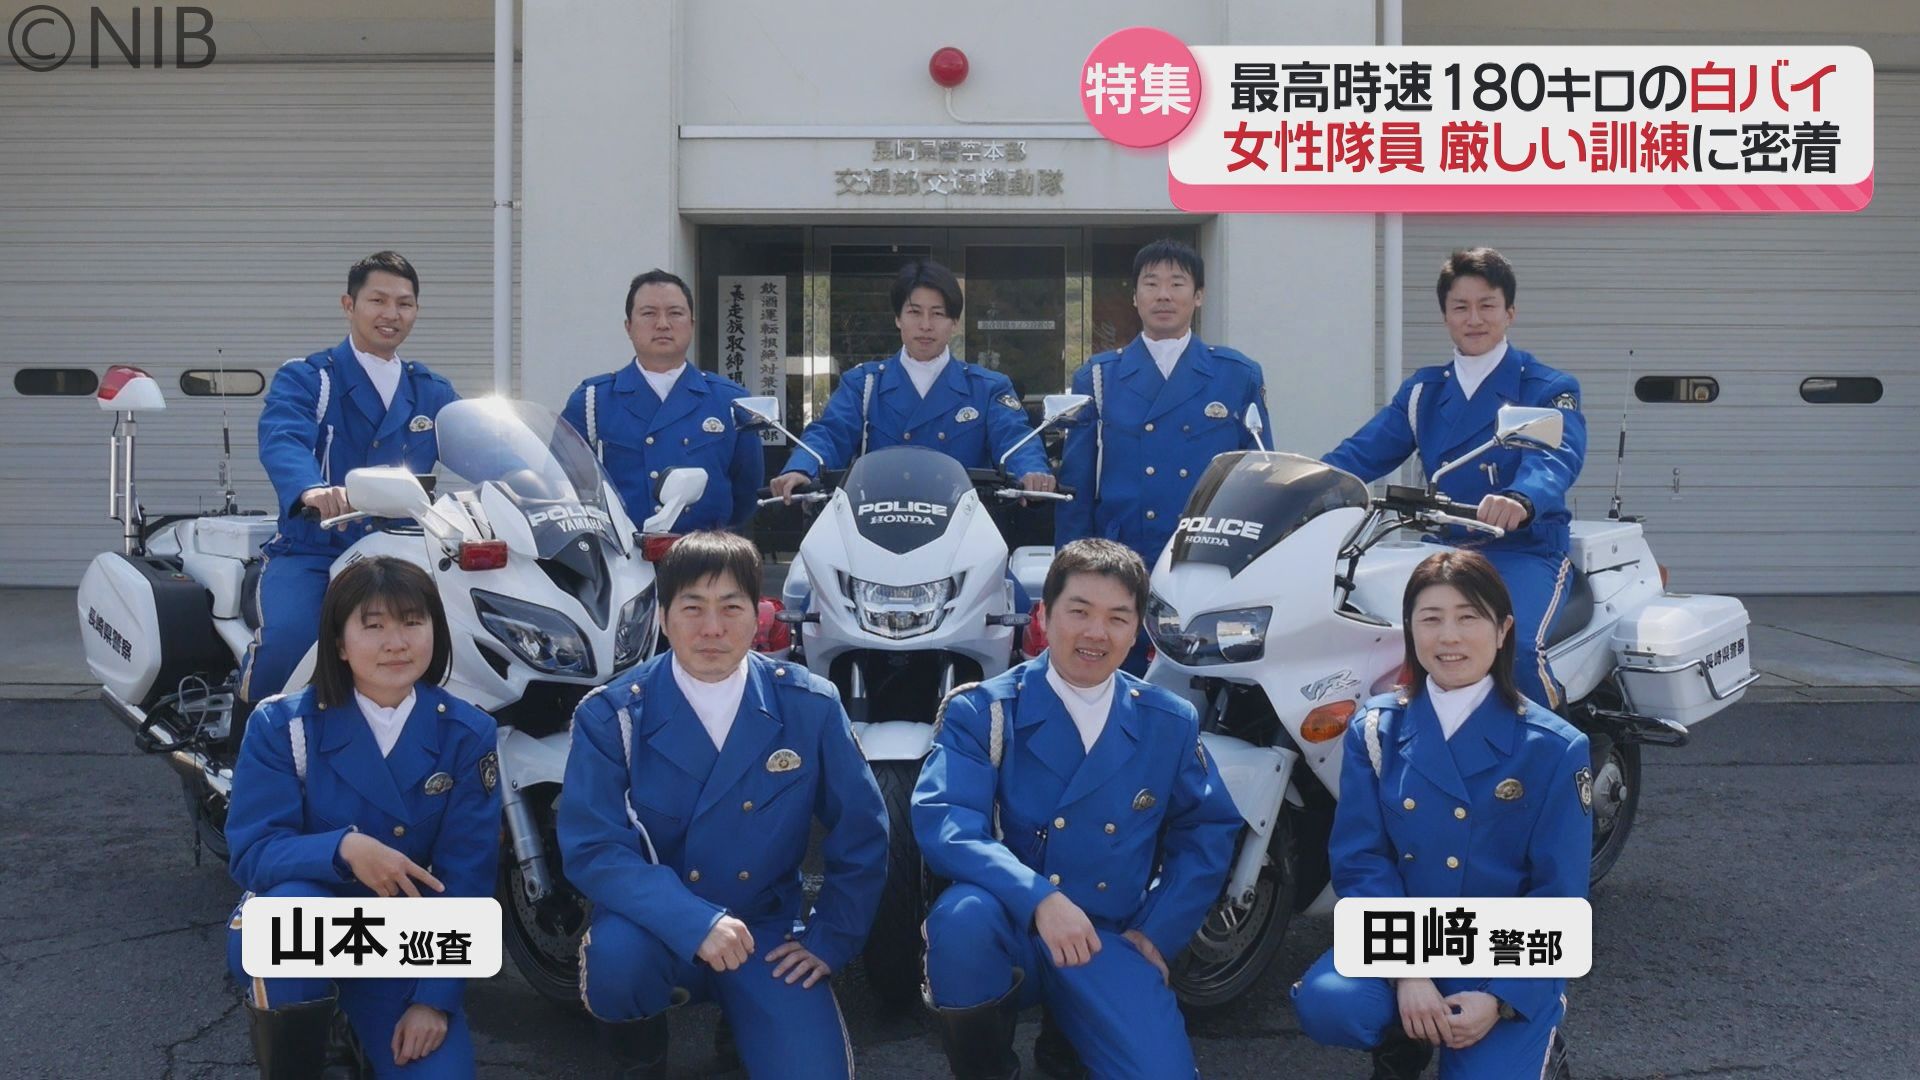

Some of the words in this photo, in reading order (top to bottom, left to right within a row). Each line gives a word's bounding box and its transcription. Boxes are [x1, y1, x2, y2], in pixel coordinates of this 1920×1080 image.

[835, 168, 1064, 196] 交通部交通機動隊
[526, 505, 612, 527] POLICE
[858, 501, 948, 517] POLICE
[870, 514, 936, 526] HONDA
[557, 518, 606, 533] YAMAHA
[1177, 517, 1264, 540] POLICE
[1184, 535, 1231, 547] HONDA
[88, 606, 132, 663] 長崎県警察
[1706, 638, 1745, 669] 長崎県警察
